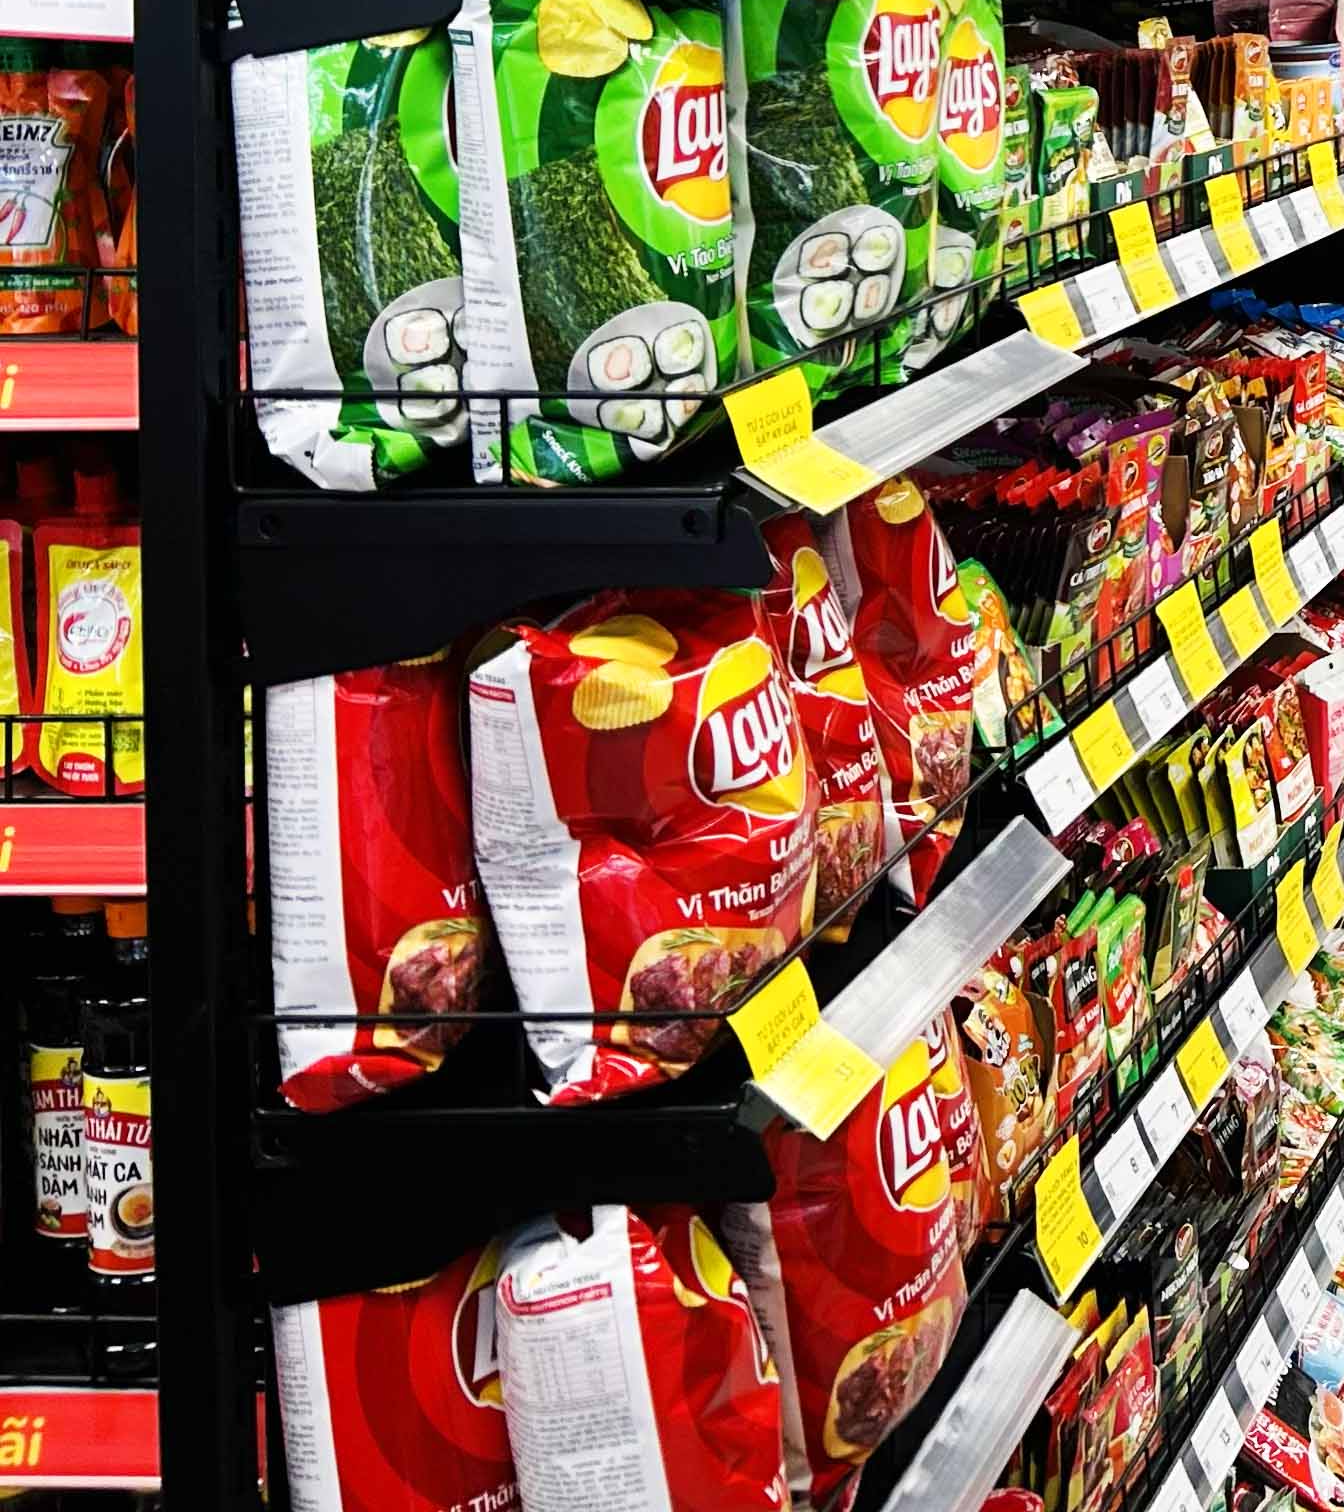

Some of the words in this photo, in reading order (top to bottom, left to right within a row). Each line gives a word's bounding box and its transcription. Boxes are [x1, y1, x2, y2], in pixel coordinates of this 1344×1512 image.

[0, 124, 52, 142] EINZ
[668, 252, 689, 279] Vị
[920, 672, 959, 702] Thăn
[677, 896, 704, 922] Vị
[708, 880, 766, 913] Thăn
[86, 1155, 108, 1181] HẤT
[873, 1299, 895, 1321] Vị
[895, 1269, 931, 1306] Thăn
